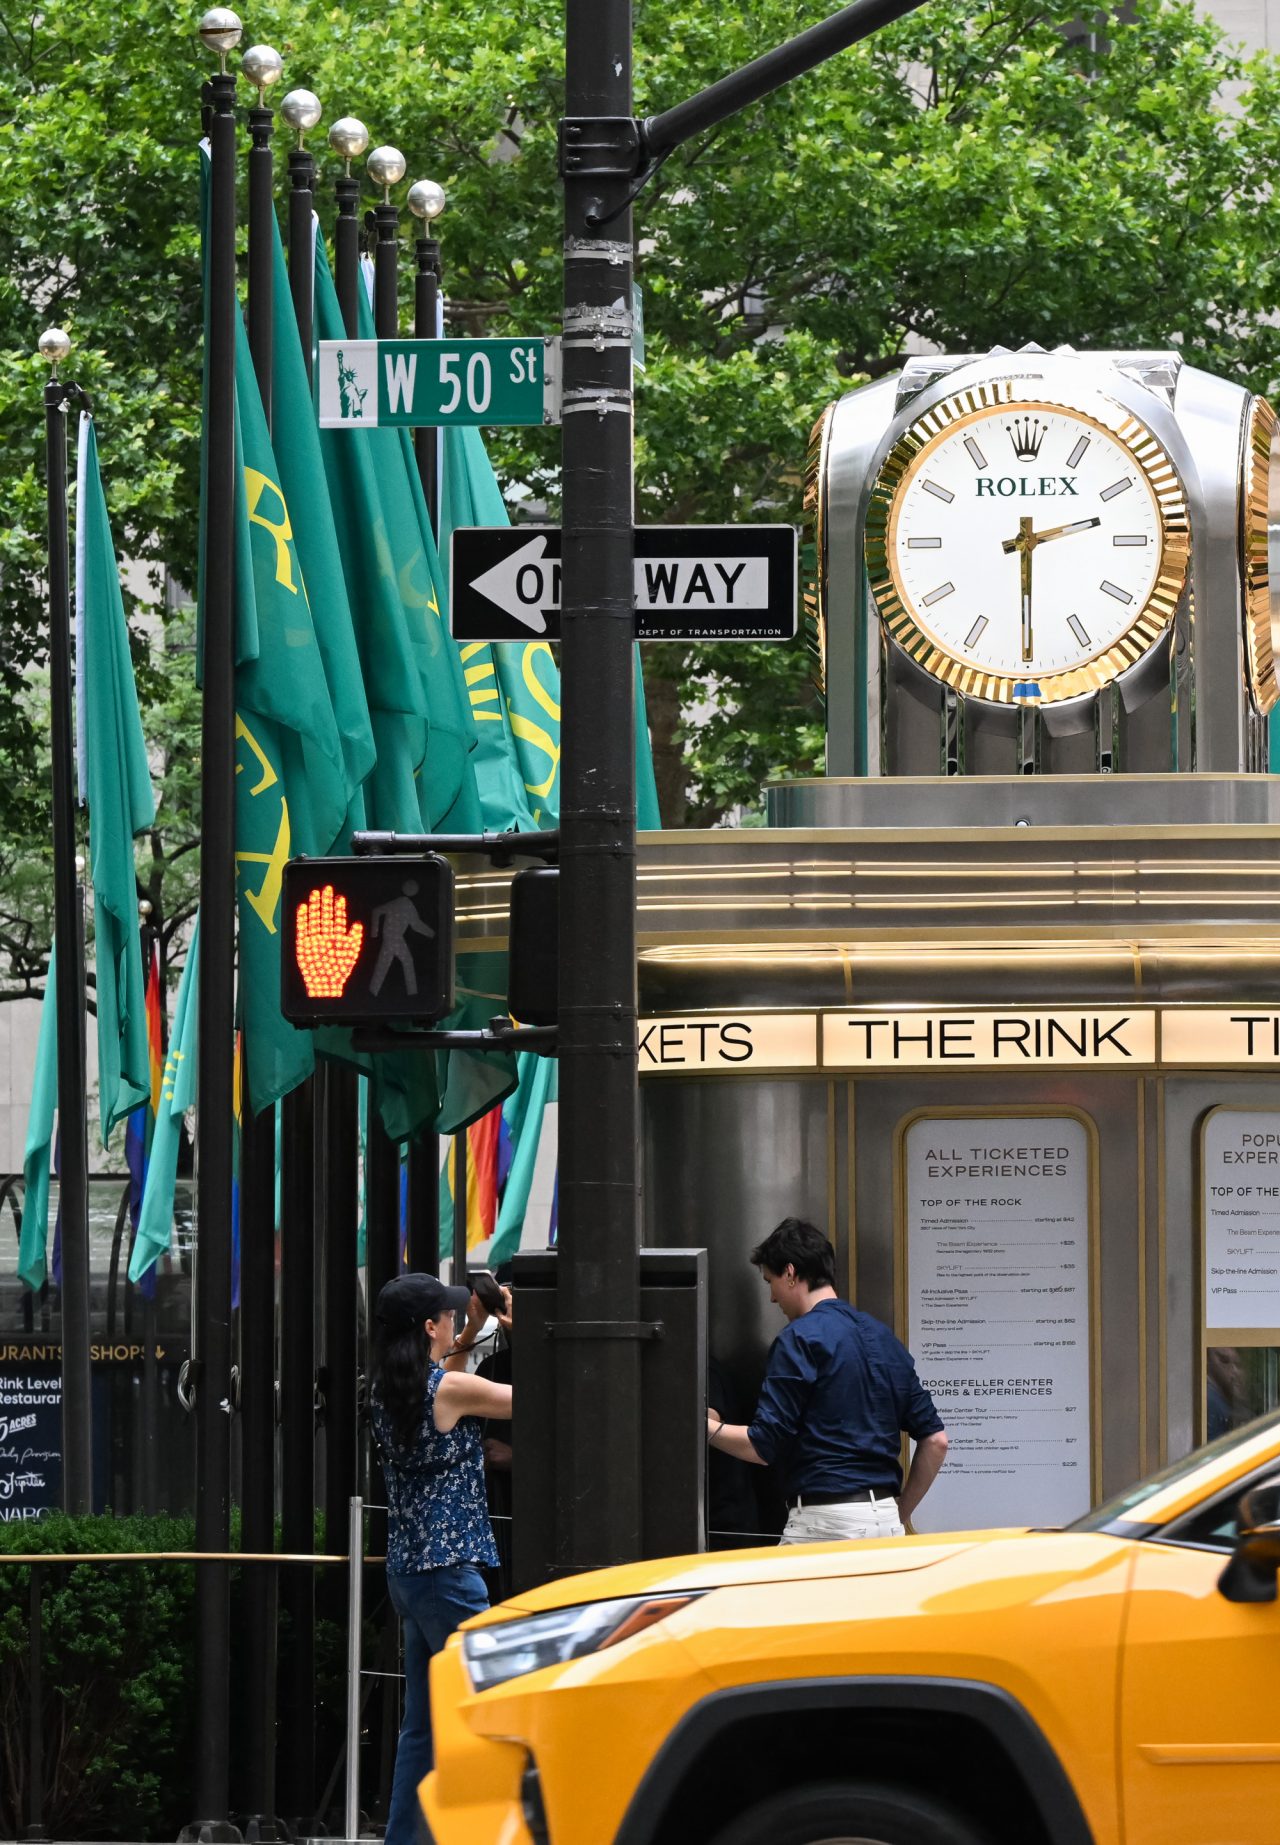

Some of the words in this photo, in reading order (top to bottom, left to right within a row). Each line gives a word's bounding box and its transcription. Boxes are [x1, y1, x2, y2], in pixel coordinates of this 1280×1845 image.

[385, 353, 417, 414] W
[438, 351, 491, 414] 50
[509, 347, 537, 384] St
[975, 476, 1079, 497] ROLEX
[645, 562, 747, 604] WAY
[638, 628, 665, 636] DEPT
[670, 628, 683, 636] OF
[688, 628, 781, 636] TRANSPORTATION
[638, 1022, 754, 1064] KETS
[848, 1019, 975, 1060] THE
[993, 1017, 1132, 1059] RINK
[925, 1148, 963, 1161] ALL
[970, 1147, 1070, 1160] TICKETED
[928, 1164, 1067, 1178] EXPERIENCES
[1210, 1186, 1234, 1197] TOP
[1236, 1186, 1252, 1197] OF
[1256, 1187, 1279, 1197] THE
[920, 1199, 943, 1207] TOP
[945, 1199, 961, 1207] OF
[965, 1198, 987, 1207] THE
[990, 1198, 1023, 1206] ROCK
[27, 1376, 62, 1390] Level
[921, 1379, 1004, 1388] ROCKEFELLER
[1007, 1378, 1053, 1387] CENTER
[0, 1391, 62, 1405] estaura
[929, 1388, 960, 1397] OURS
[962, 1388, 971, 1396] &
[974, 1387, 1053, 1396] EXPERIENCES
[9, 1412, 37, 1433] ACRES
[19, 1447, 62, 1466] Provision
